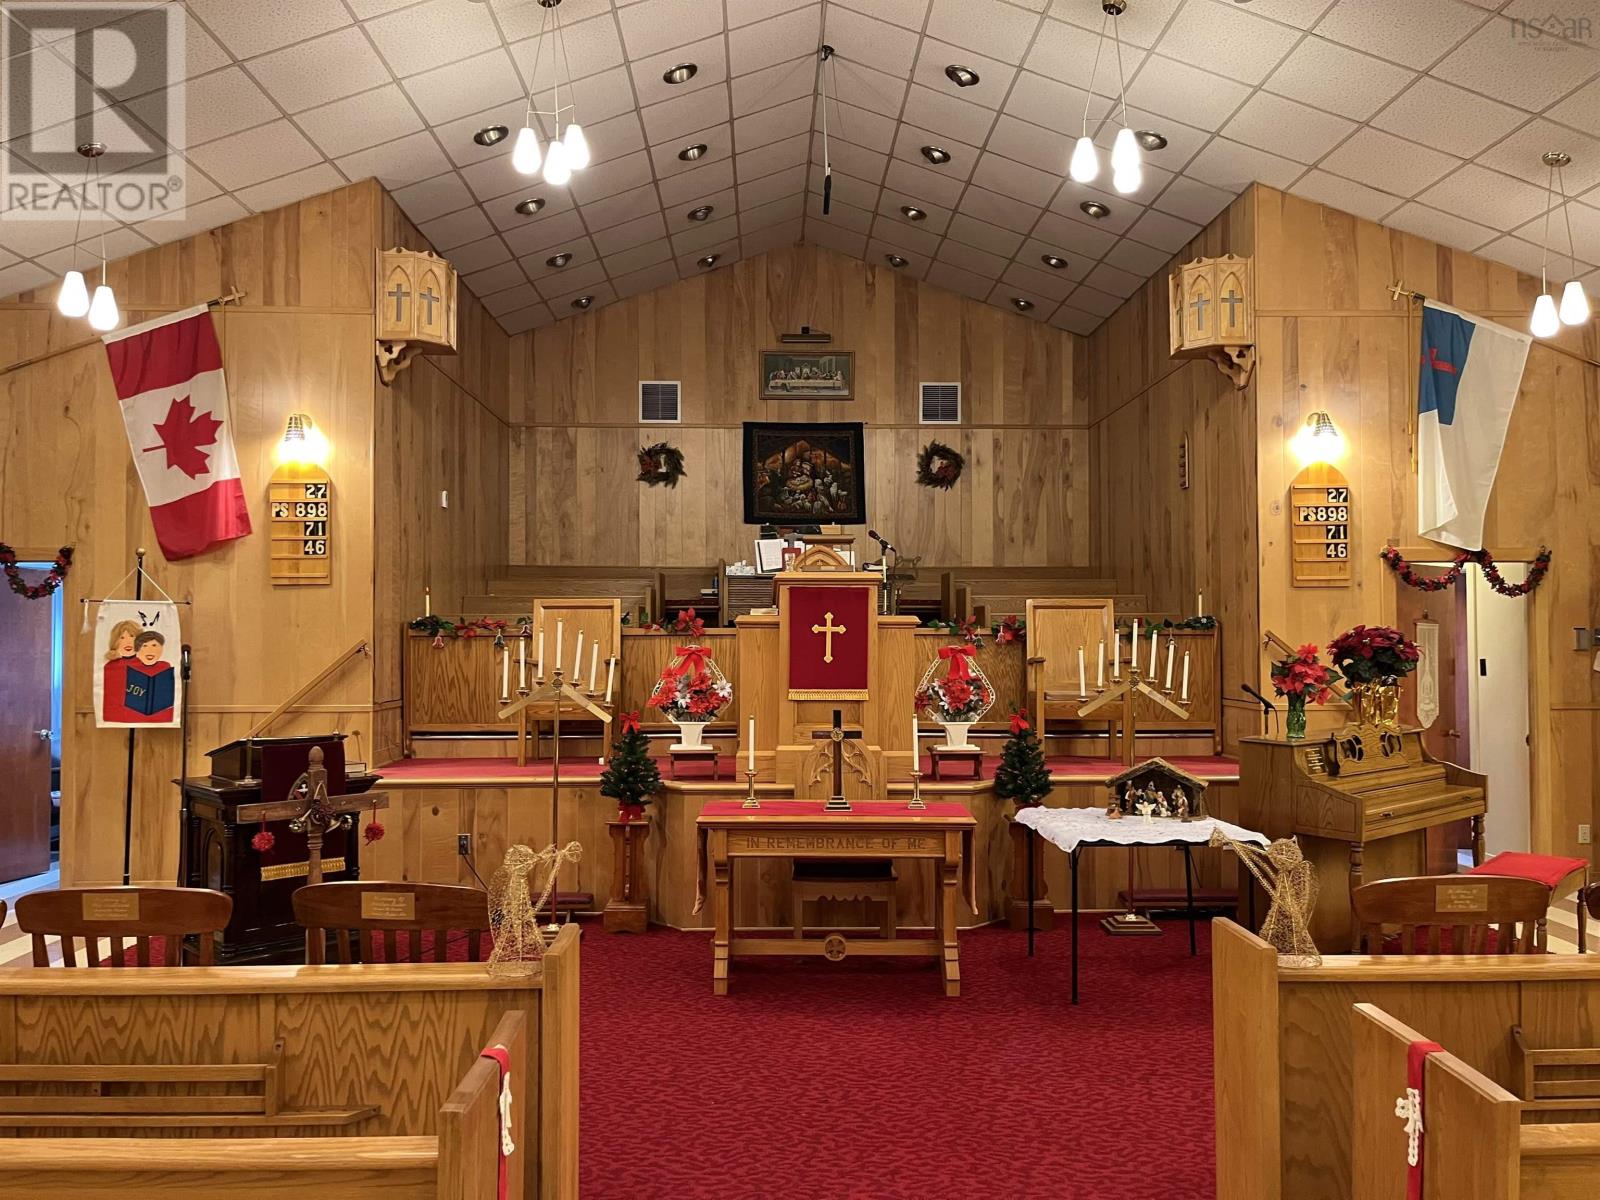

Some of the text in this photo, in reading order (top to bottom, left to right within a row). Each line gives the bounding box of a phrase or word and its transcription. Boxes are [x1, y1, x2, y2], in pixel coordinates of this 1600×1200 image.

[306, 484, 326, 499] 27
[1327, 488, 1347, 503] 27
[271, 502, 328, 518] PS 898
[305, 521, 323, 536] 71
[1327, 525, 1345, 540] 71
[304, 540, 325, 555] 46
[1326, 543, 1347, 558] 46
[126, 684, 147, 697] JOY
[746, 836, 926, 850] IN REMEMBRANCE OF ME
